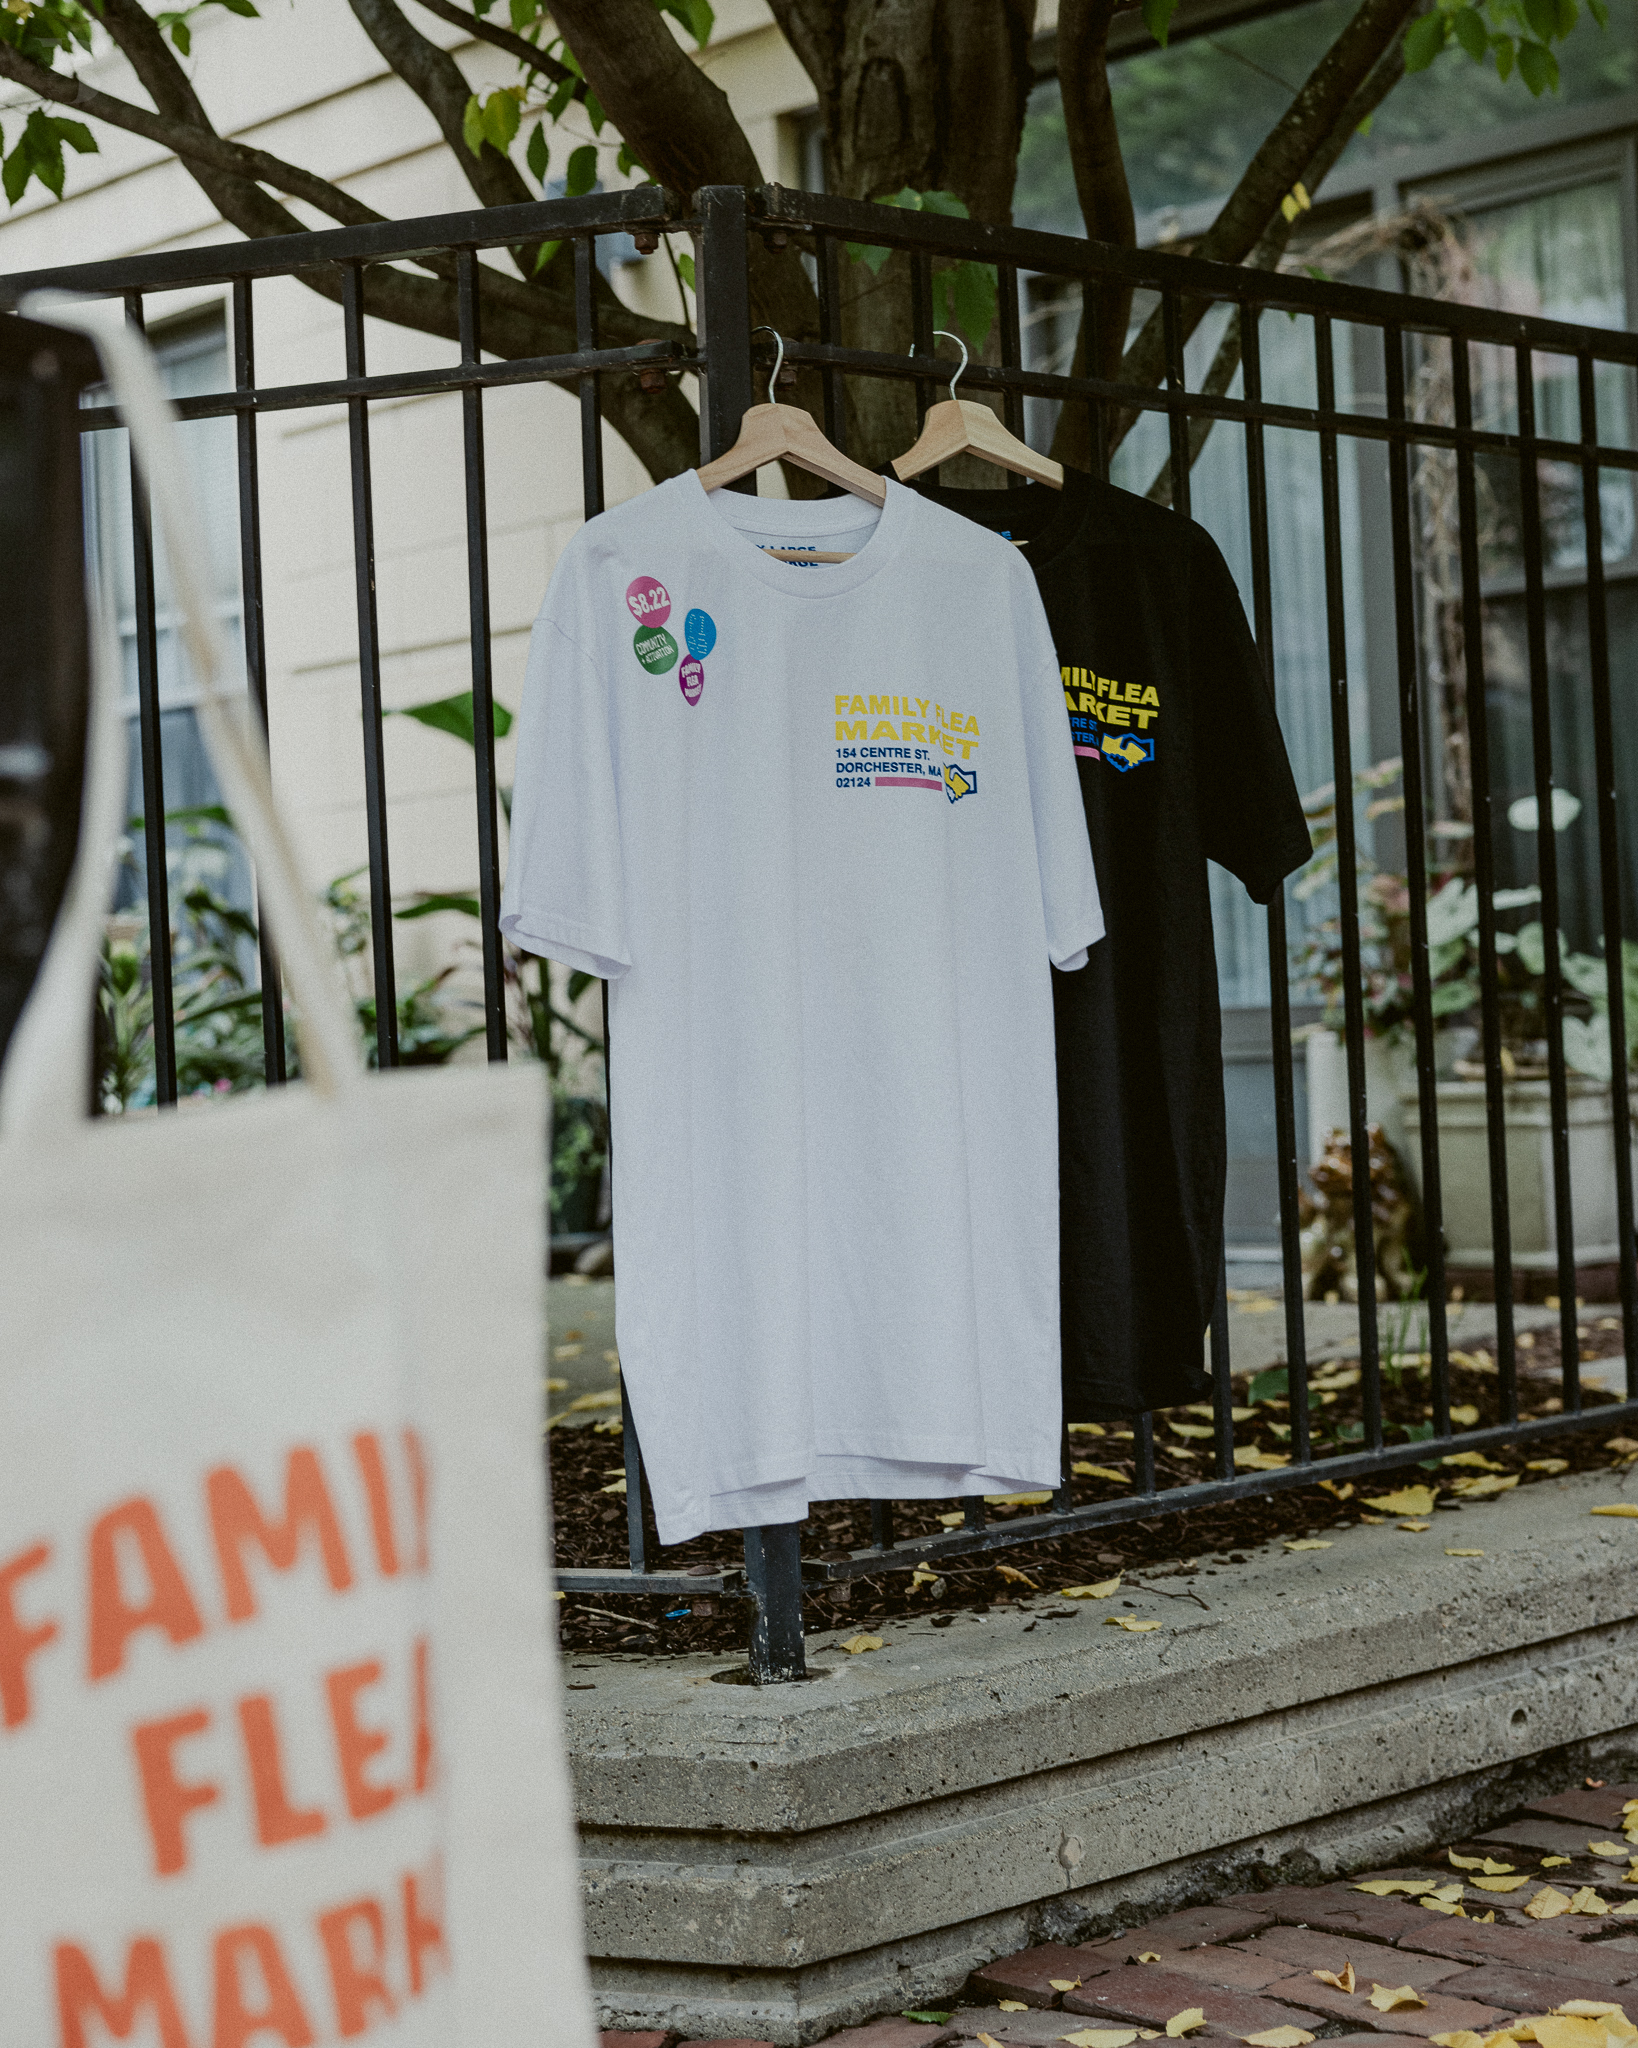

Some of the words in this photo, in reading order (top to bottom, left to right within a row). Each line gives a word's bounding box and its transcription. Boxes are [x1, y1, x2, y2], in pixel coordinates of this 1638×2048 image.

[628, 586, 670, 618] $8.22
[1097, 676, 1160, 707] FLEA
[834, 694, 930, 719] FAMILY
[935, 703, 980, 736] FLEA
[834, 720, 979, 760] MARKET
[836, 747, 857, 759] 154
[860, 746, 911, 759] CENTRE
[915, 748, 930, 761] ST.
[836, 762, 926, 776] DORCHESTER,
[928, 764, 942, 778] MA
[836, 776, 871, 788] 02124
